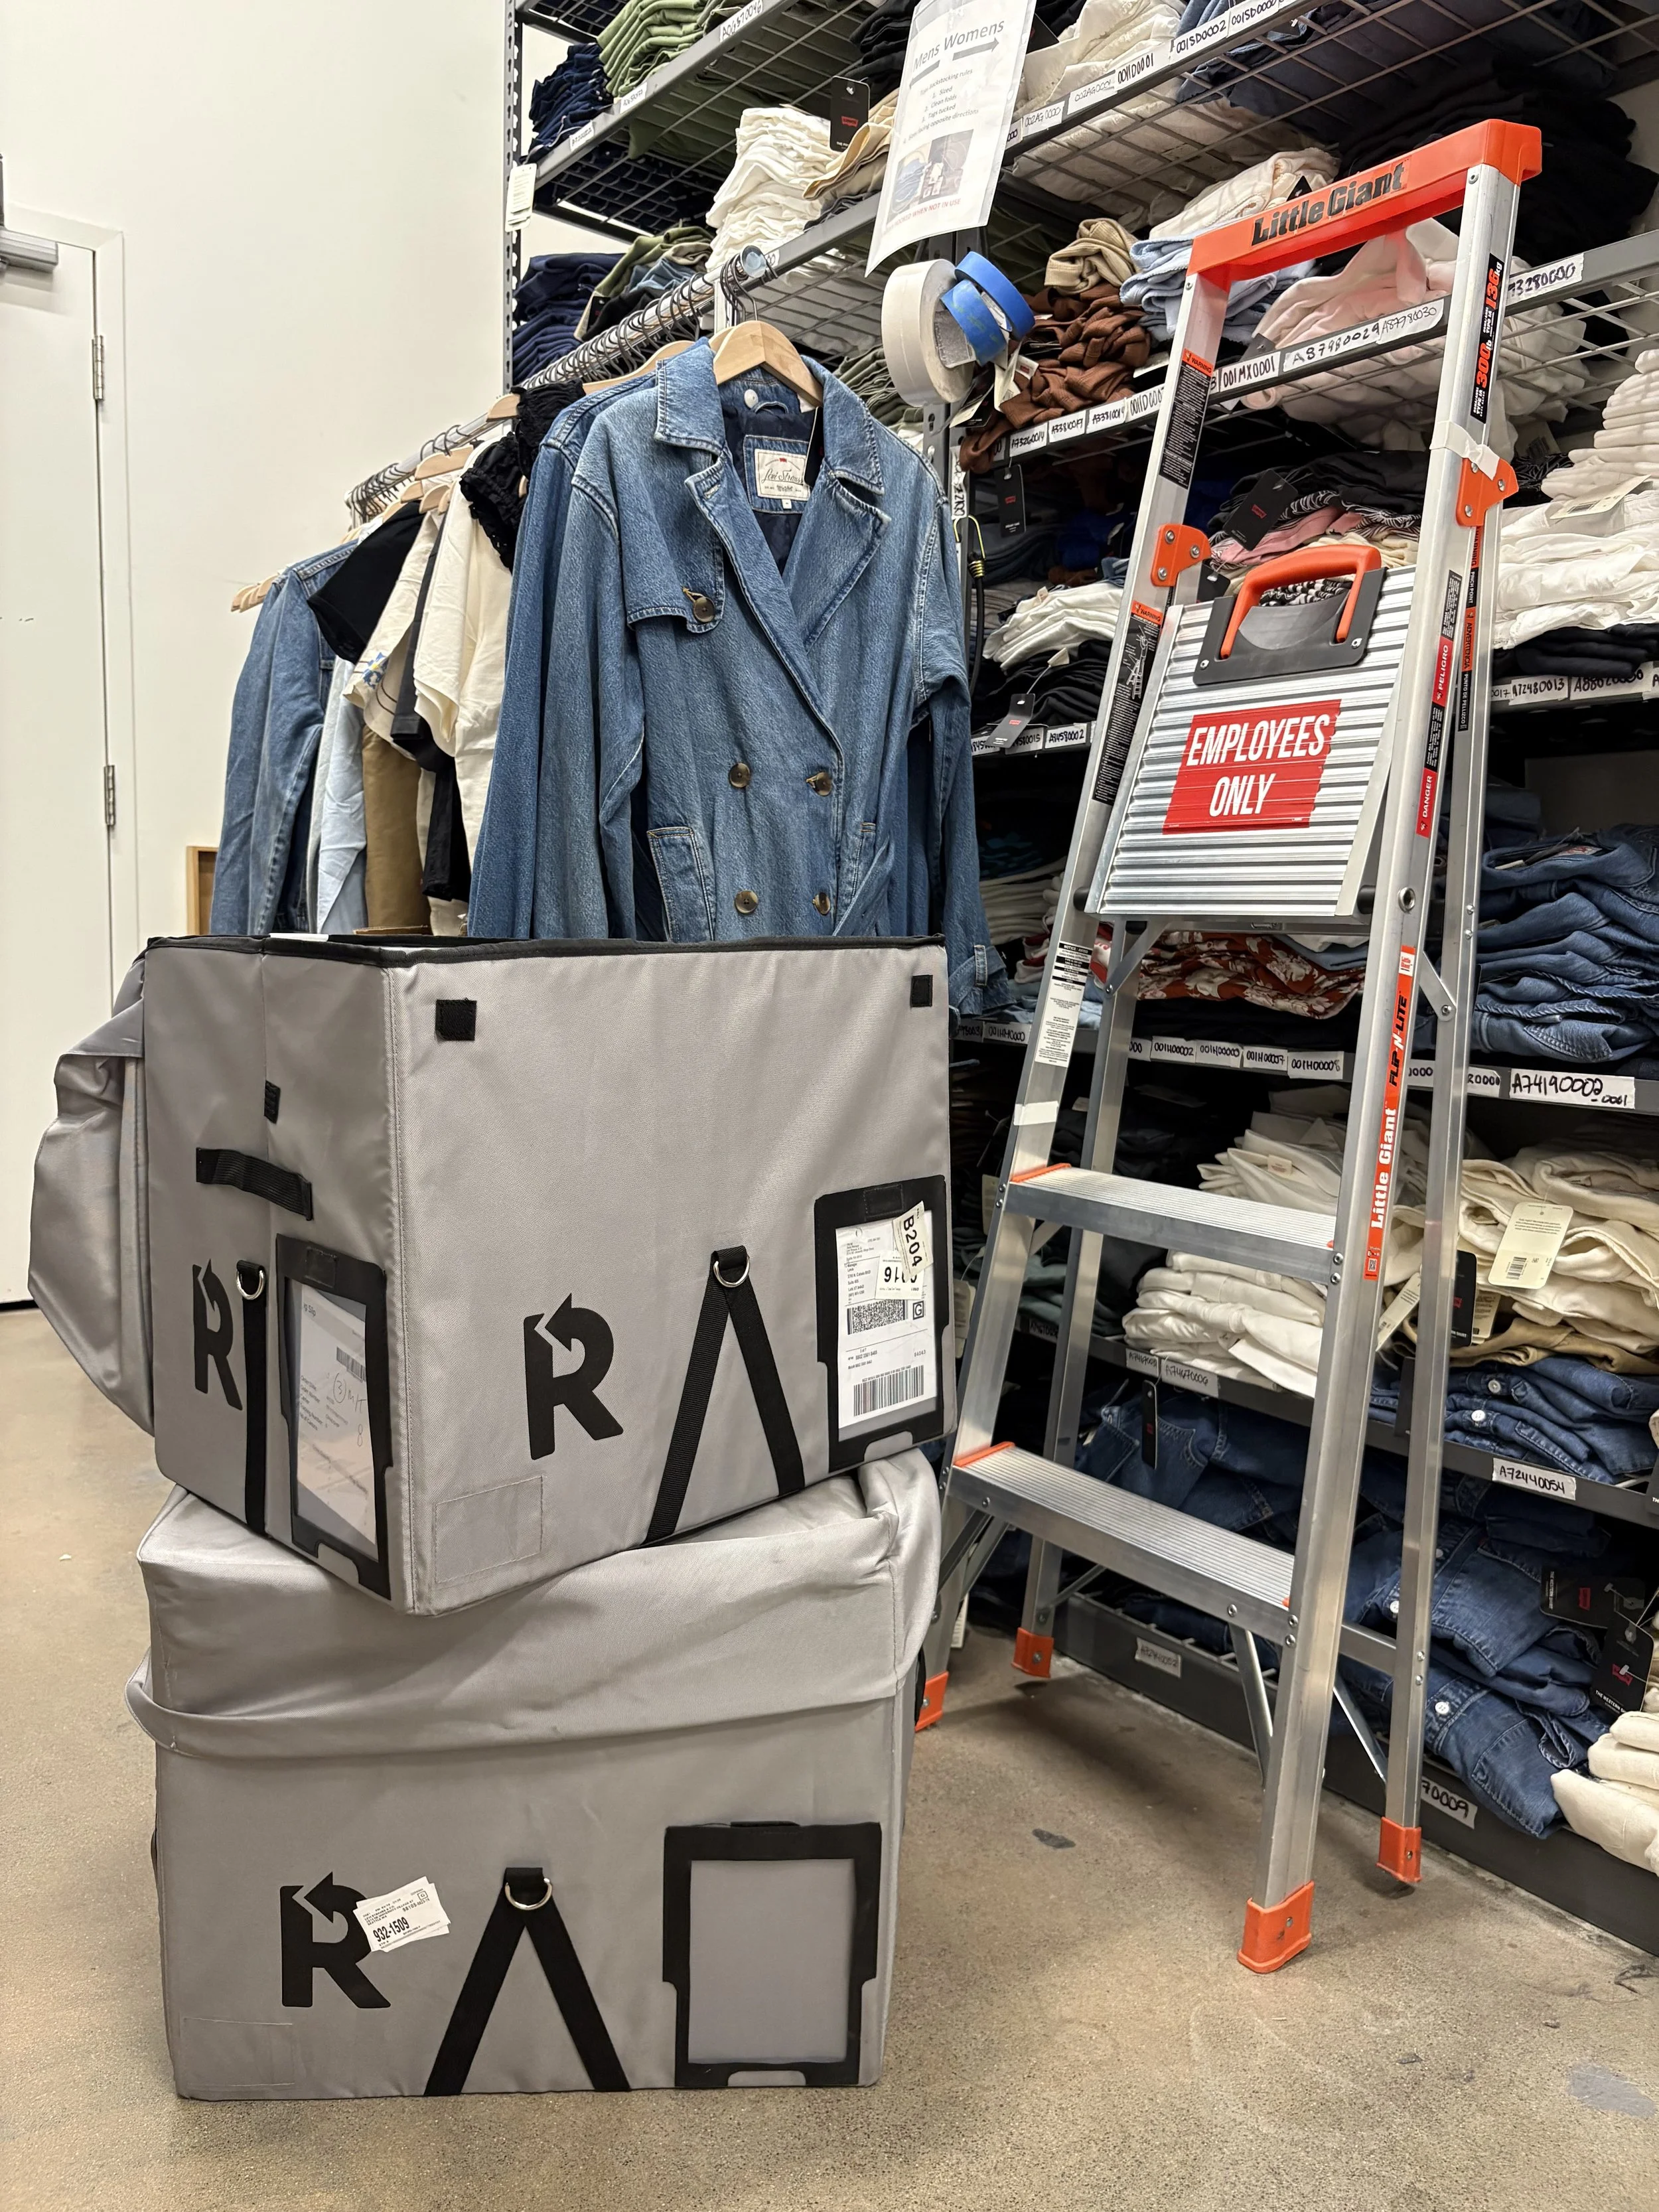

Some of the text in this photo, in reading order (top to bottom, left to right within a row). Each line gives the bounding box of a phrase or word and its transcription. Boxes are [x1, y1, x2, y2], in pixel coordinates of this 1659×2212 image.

[913, 21, 1005, 72] Mens Womens
[1251, 161, 1405, 246] Little Giant
[1191, 357, 1212, 374] WARNING
[1140, 609, 1161, 622] WARNING
[1438, 645, 1449, 691] PELIGRO
[1186, 714, 1330, 767] EMPLOYEES
[1209, 773, 1276, 817] ONLY
[1423, 775, 1432, 818] DANGER
[1389, 994, 1407, 1087] FLIP-N-LITE
[1370, 1108, 1397, 1229] Little Giant
[903, 1215, 923, 1267] B204
[308, 1304, 317, 1317] Slip
[914, 1303, 923, 1316] G
[1499, 1465, 1565, 1495] A72440054
[1603, 1695, 1621, 1709] WESTERN
[372, 1916, 410, 1943] 932-1509
